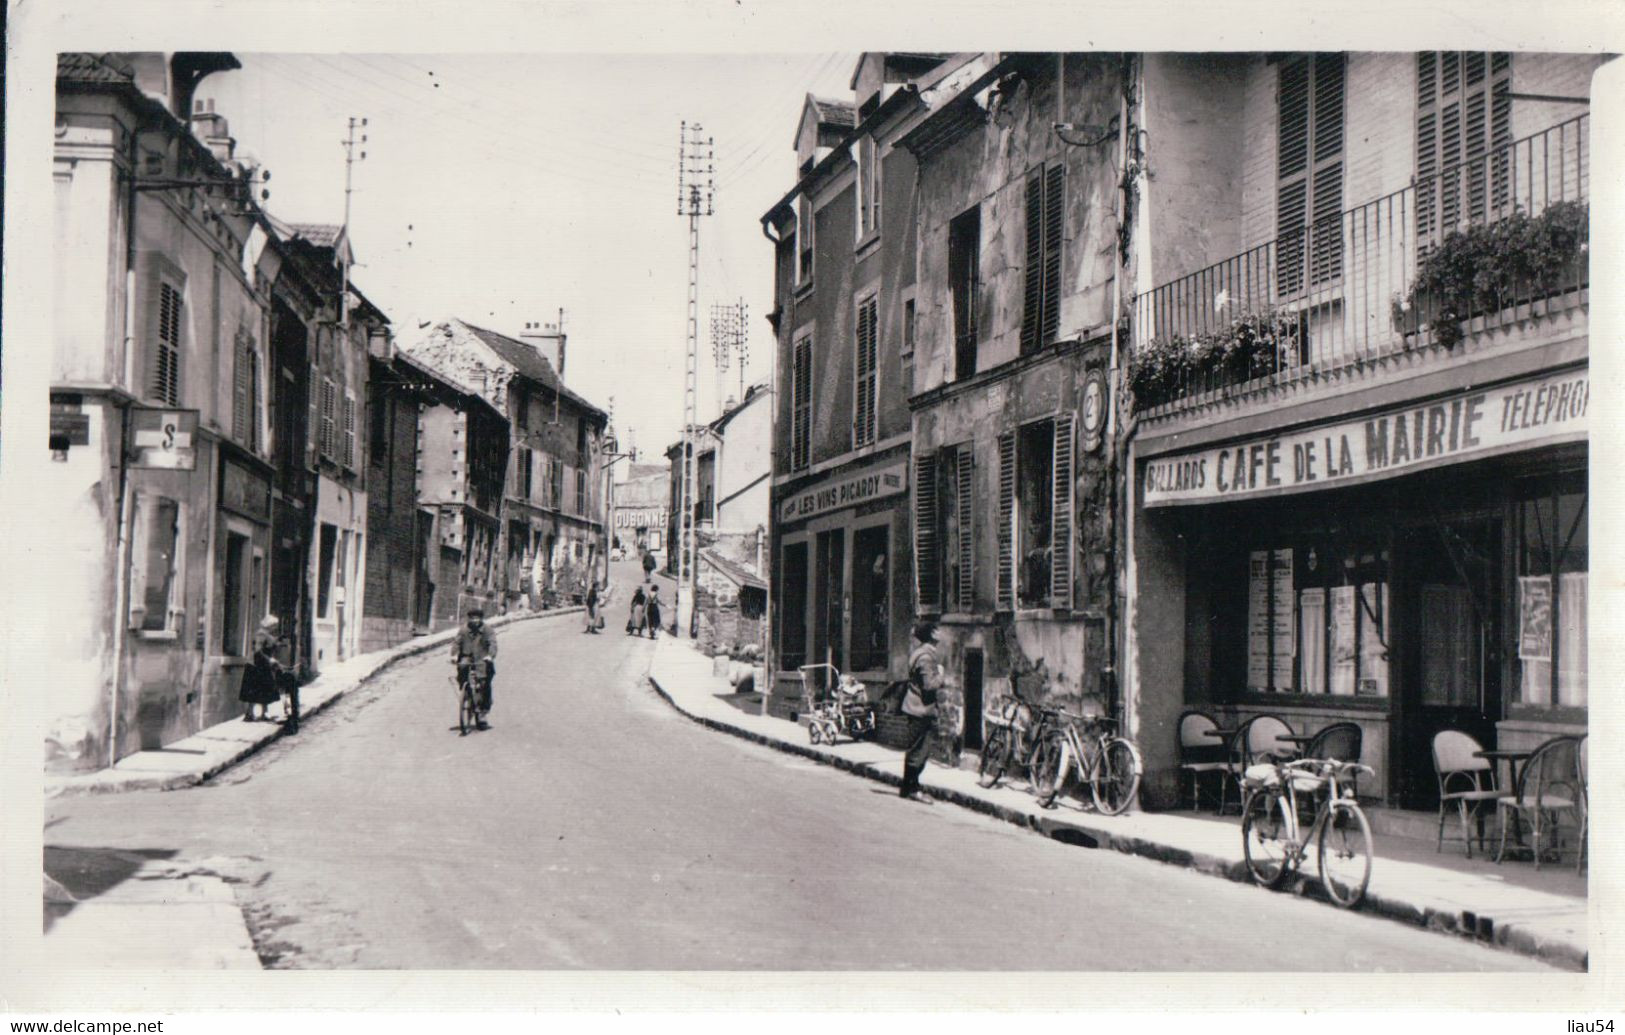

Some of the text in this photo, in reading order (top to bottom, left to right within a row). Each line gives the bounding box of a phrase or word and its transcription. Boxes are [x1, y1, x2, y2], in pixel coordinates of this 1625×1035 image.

[162, 423, 175, 449] S
[1147, 458, 1206, 493] BILLARDS
[1216, 436, 1281, 493] CAFÉ
[1294, 441, 1316, 483] DE
[1325, 433, 1354, 477] LA
[1365, 395, 1486, 470] MAIRIE
[798, 495, 815, 515] LES
[817, 487, 837, 508] VINS
[840, 474, 881, 502] PICARDY
